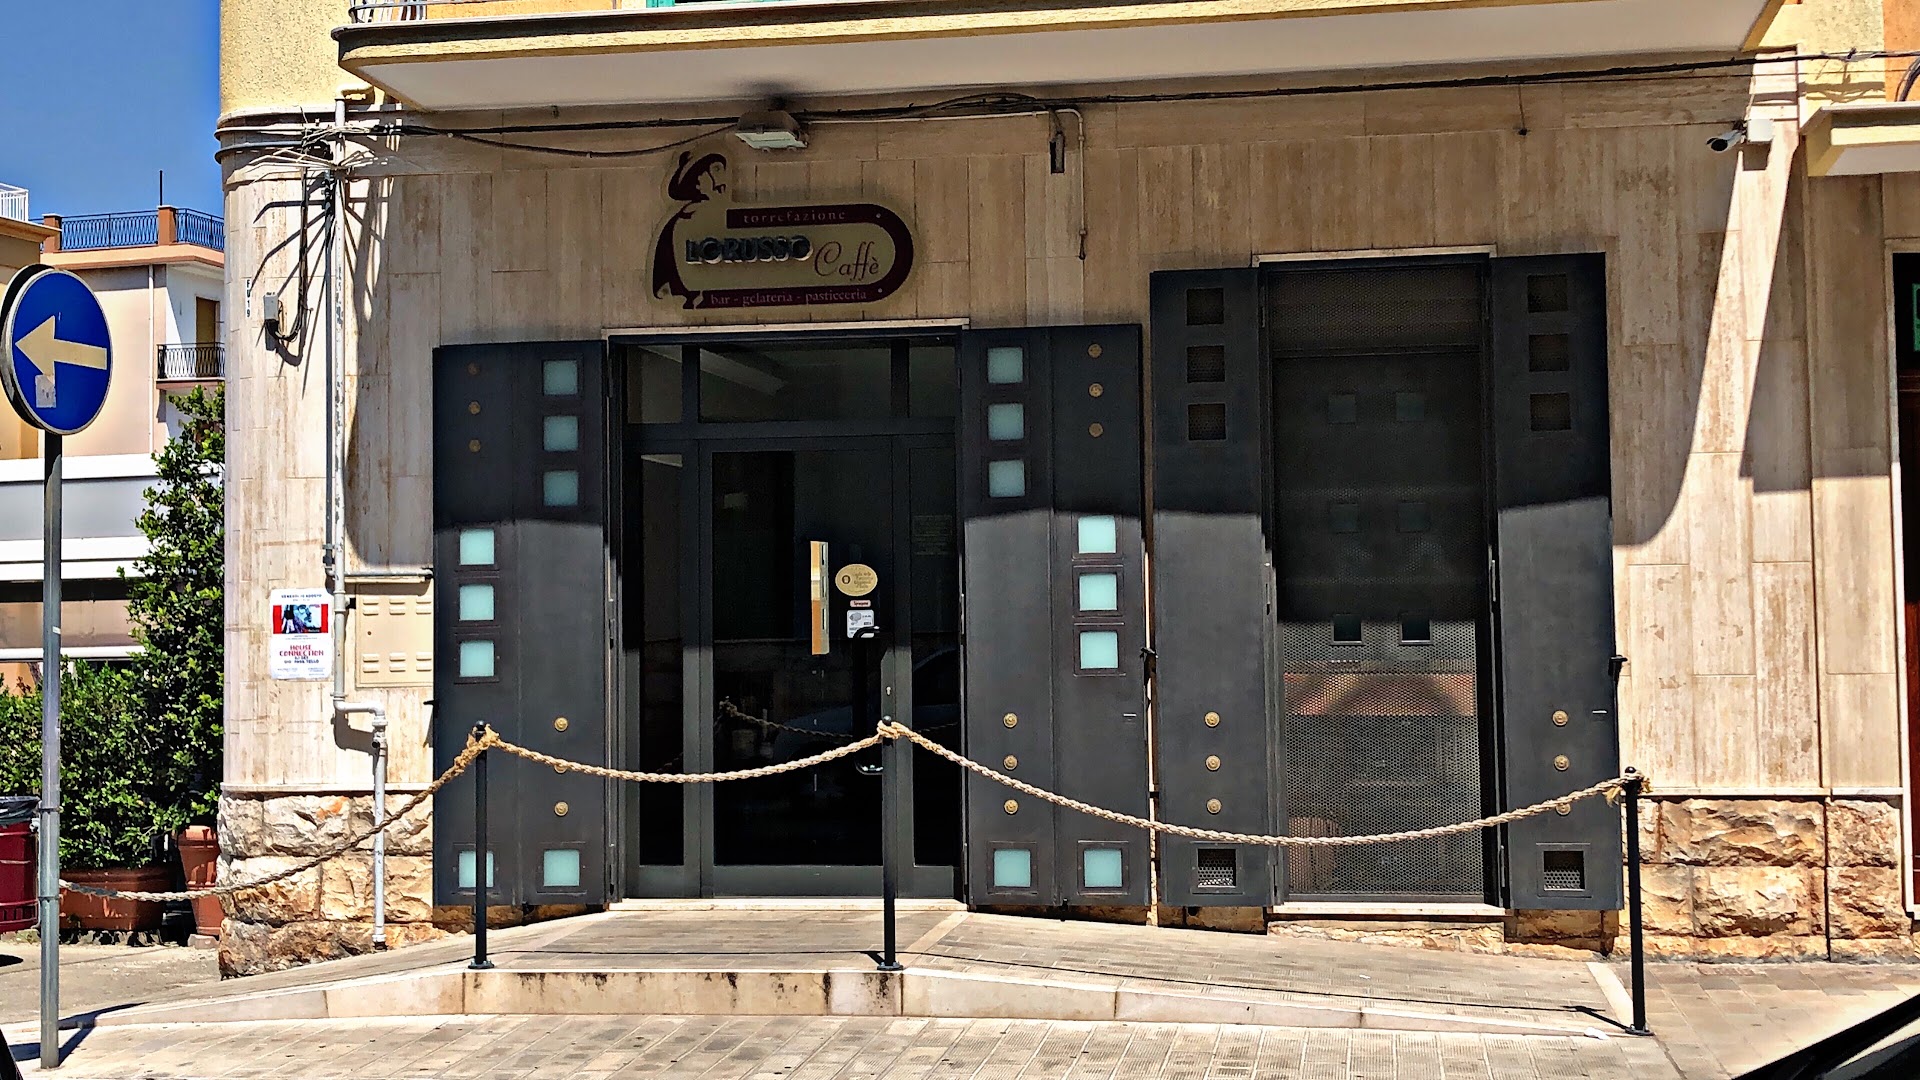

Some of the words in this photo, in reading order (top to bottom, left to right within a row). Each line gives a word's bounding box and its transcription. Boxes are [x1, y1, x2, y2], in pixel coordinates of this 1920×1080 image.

[743, 209, 847, 224] torrefazione
[685, 234, 814, 265] LORUSSO
[813, 240, 880, 282] Caffè
[710, 293, 731, 305] bar
[742, 292, 793, 307] gelateria
[805, 289, 867, 305] pasticceria
